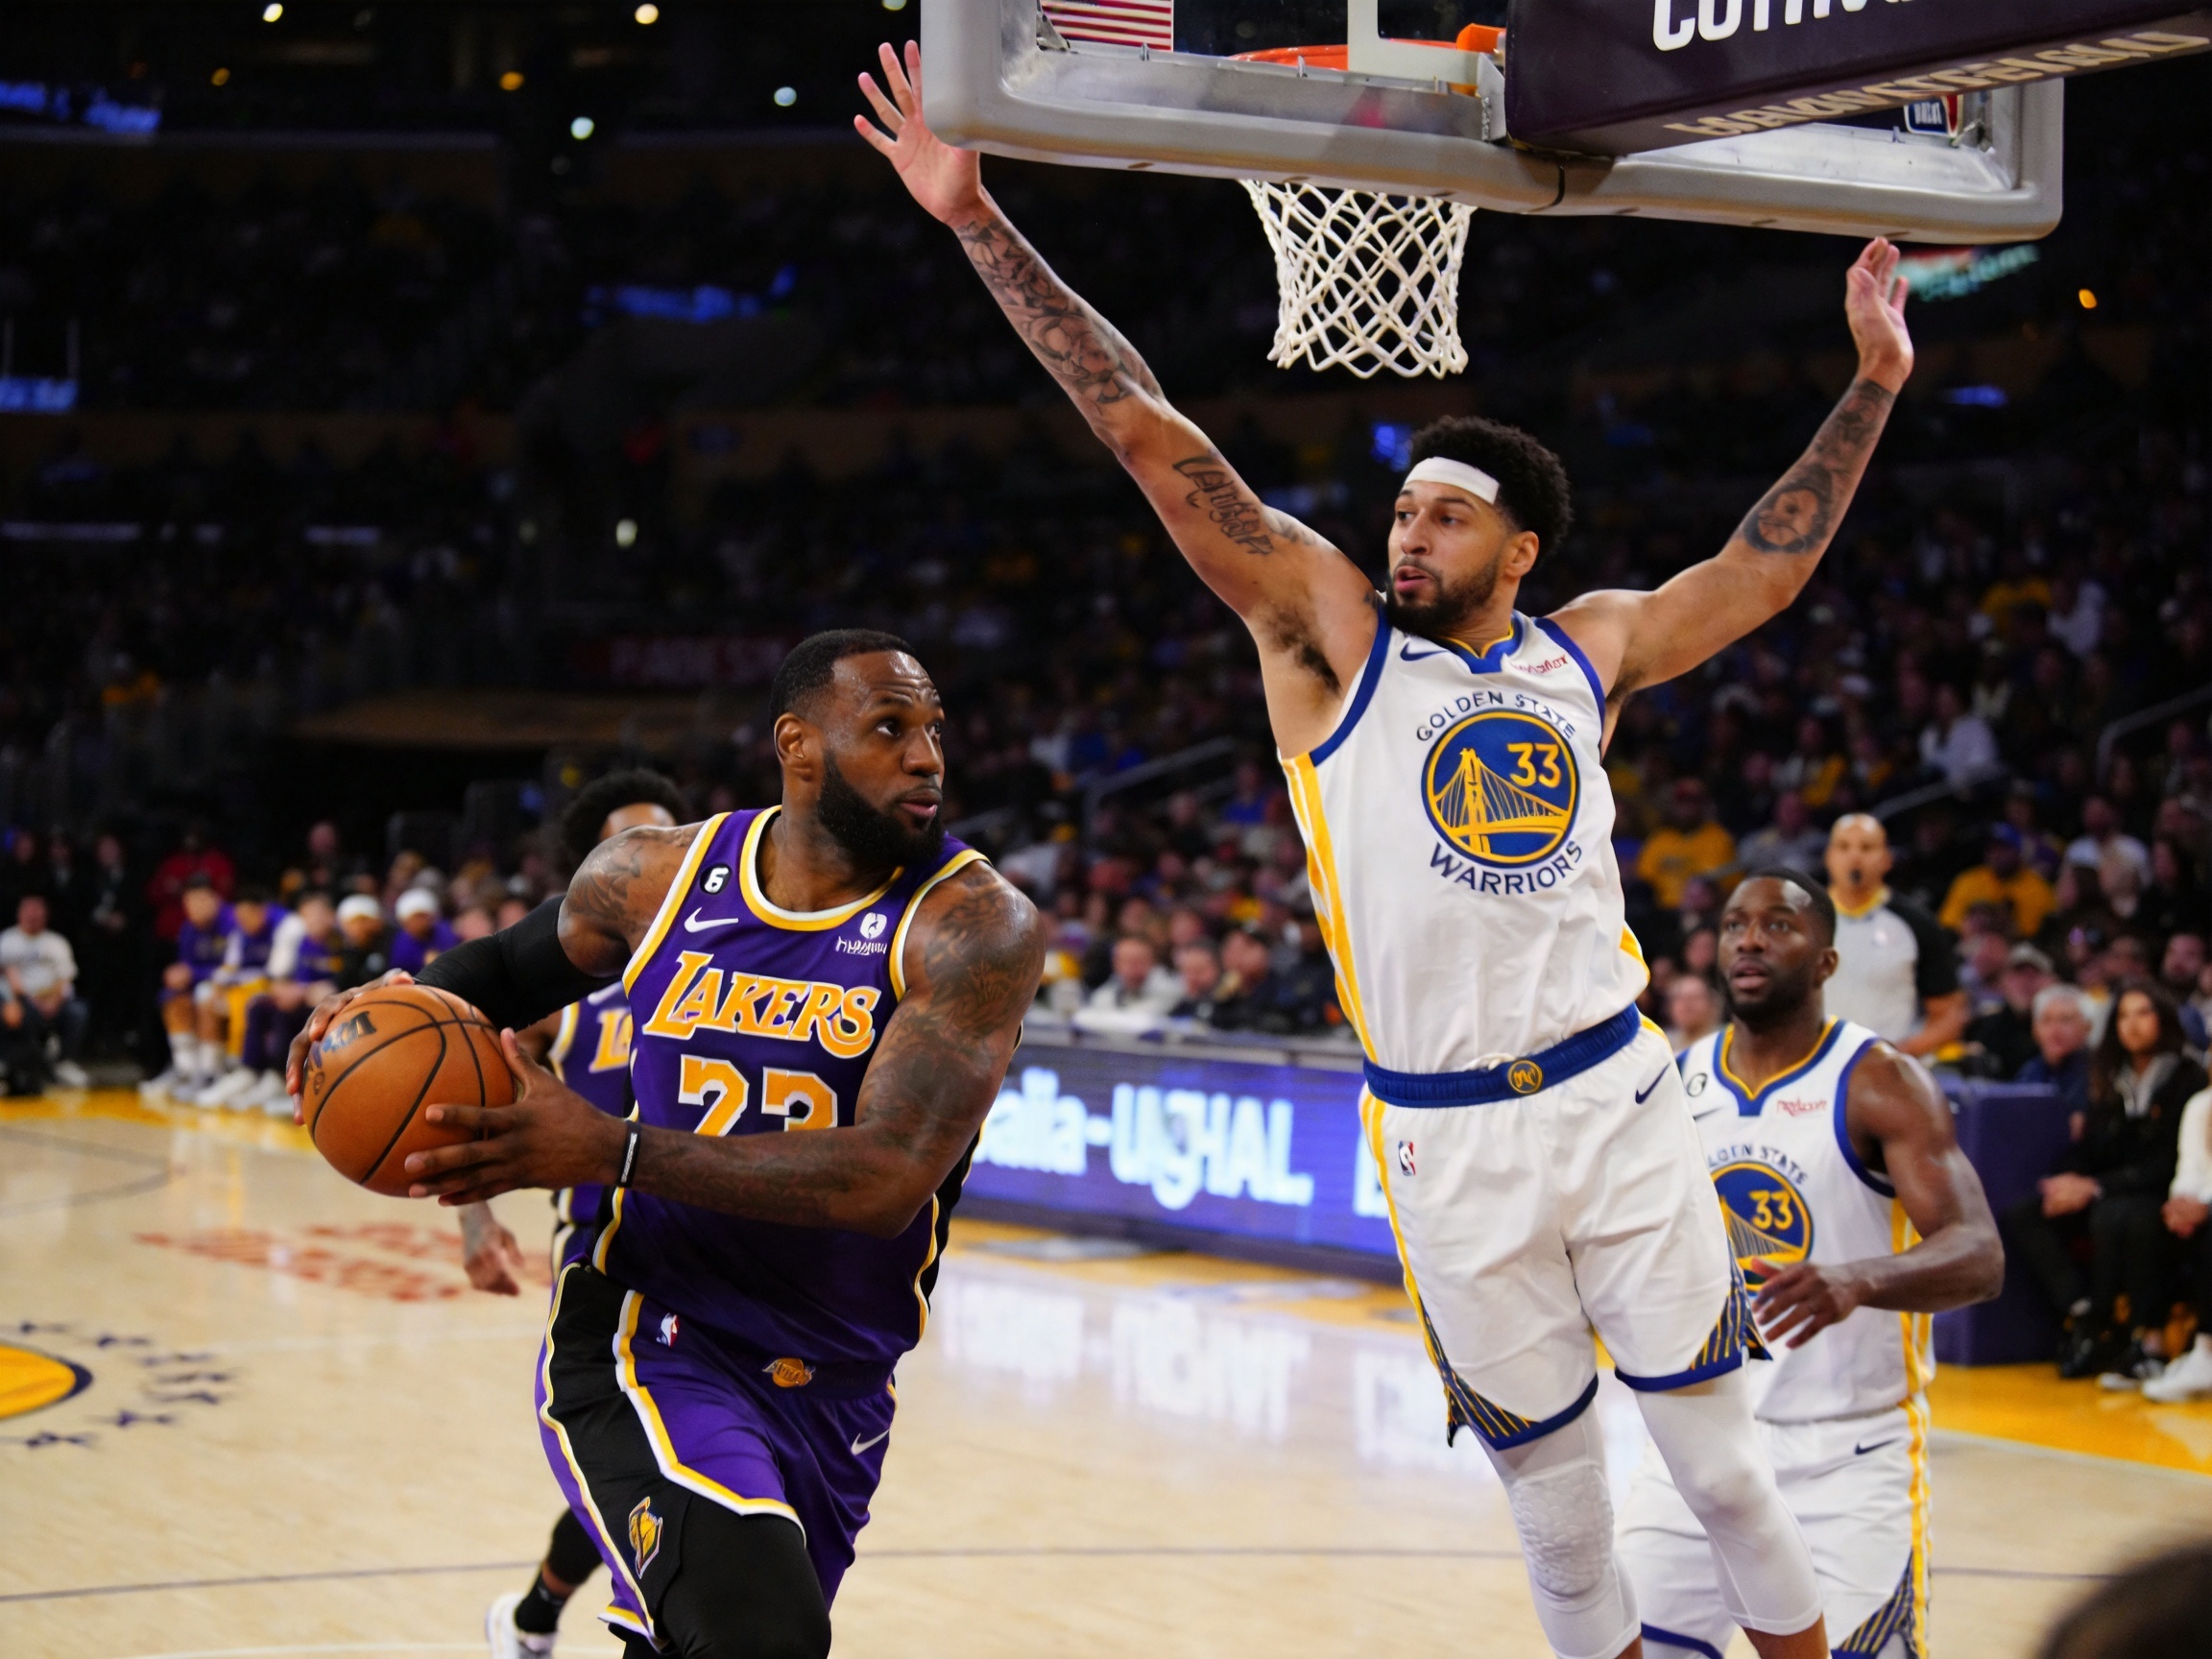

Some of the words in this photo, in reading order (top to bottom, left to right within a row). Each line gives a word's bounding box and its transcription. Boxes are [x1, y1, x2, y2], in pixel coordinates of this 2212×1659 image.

[1416, 690, 1504, 741] GOLDEN
[1506, 742, 1562, 788] 33
[704, 866, 729, 894] 6
[1430, 840, 1582, 895] WARRIORS
[641, 950, 882, 1059] LAKERS
[1748, 1190, 1793, 1231] 33
